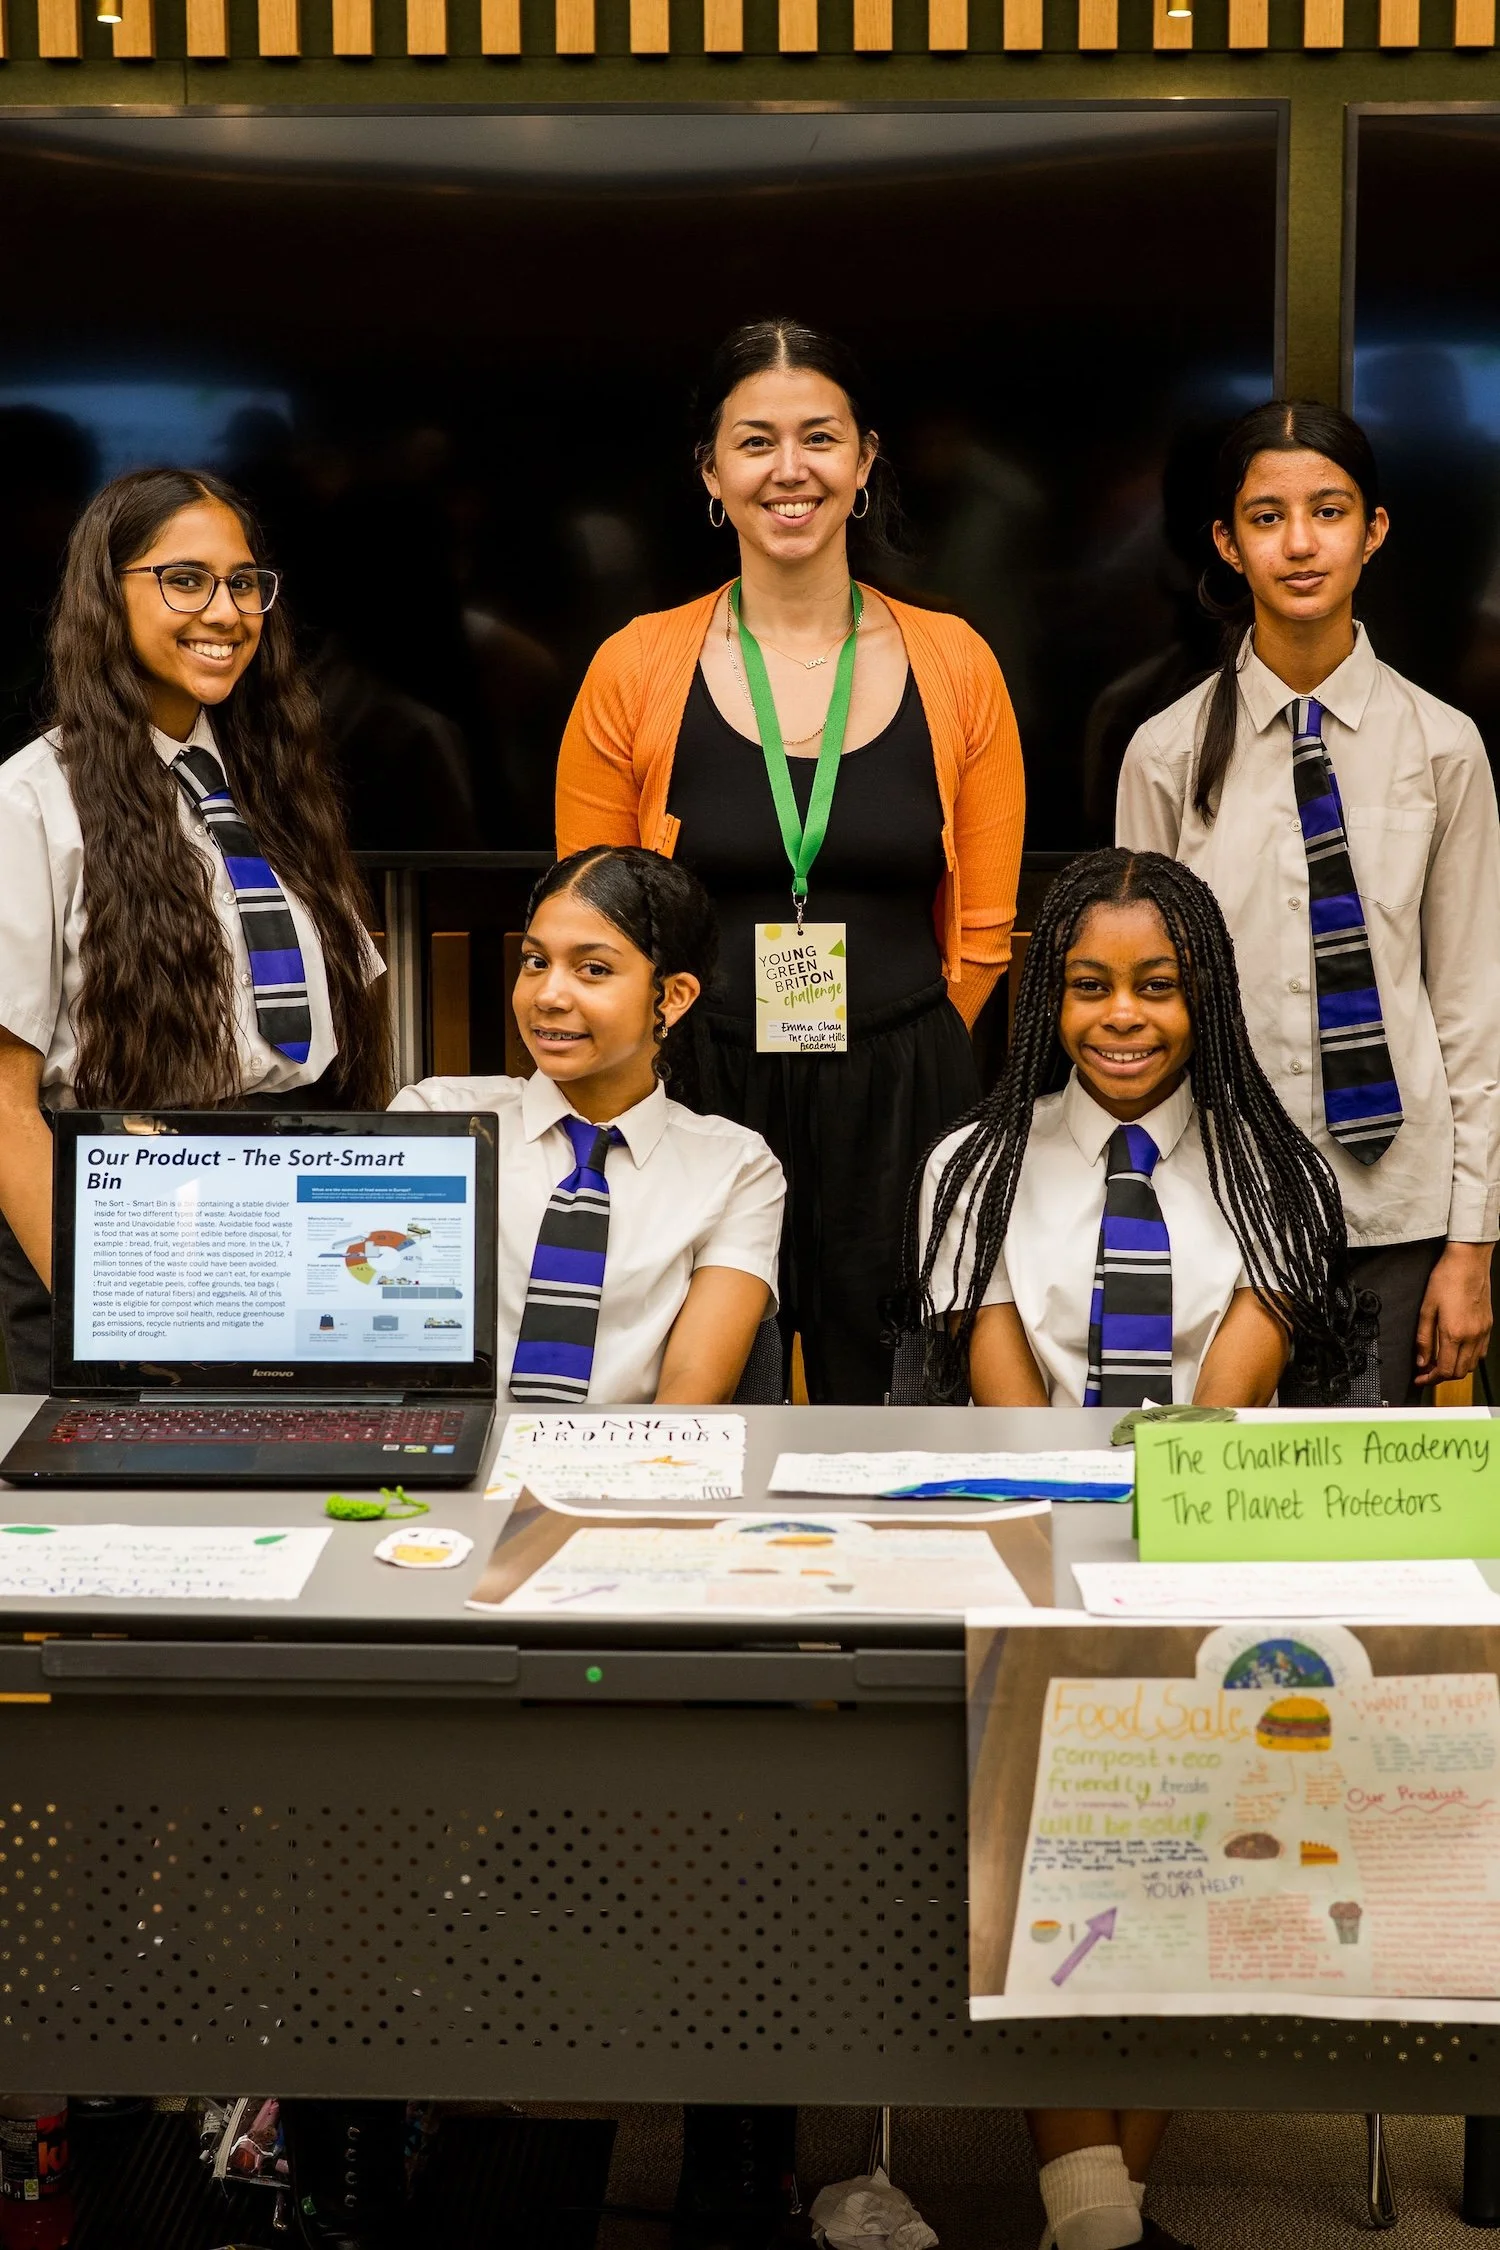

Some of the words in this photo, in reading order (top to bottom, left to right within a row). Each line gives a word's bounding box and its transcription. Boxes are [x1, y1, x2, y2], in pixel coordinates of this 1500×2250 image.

[759, 946, 817, 967] YOUNG
[766, 959, 817, 980] GREEN
[775, 970, 834, 992] BRITON
[784, 982, 842, 1008] challenge
[782, 1022, 814, 1032] Emma
[804, 1033, 825, 1042] Chalk
[829, 1032, 845, 1041] Hills
[800, 1042, 836, 1052] Academy
[87, 1148, 129, 1166] Our
[135, 1148, 220, 1166] Product
[242, 1149, 280, 1166] The
[289, 1150, 405, 1166] Sort-Smart
[87, 1172, 121, 1189] Bin
[174, 1210, 193, 1219] types
[222, 1250, 254, 1259] disposed
[265, 1250, 285, 1259] 2012,
[234, 1270, 248, 1279] eat,
[261, 1270, 291, 1279] example
[165, 1280, 186, 1289] peels,
[212, 1280, 242, 1289] grounds,
[258, 1280, 275, 1289] bags
[172, 1290, 195, 1299] fibers)
[123, 1300, 148, 1309] eligible
[162, 1300, 192, 1309] compost
[255, 1300, 285, 1309] compost
[147, 1310, 174, 1319] improve
[190, 1310, 214, 1319] health,
[147, 1320, 171, 1329] recycle
[222, 1320, 250, 1329] mitigate
[138, 1330, 167, 1339] drought.
[253, 1369, 294, 1377] lenovo
[539, 1419, 708, 1429] PLANET
[1154, 1436, 1206, 1475] The
[1363, 1430, 1490, 1473] Academy
[1162, 1491, 1214, 1526] The
[1226, 1488, 1304, 1522] Planet
[1324, 1484, 1442, 1520] Protectors
[1054, 1682, 1144, 1732] Food
[1155, 1684, 1244, 1734] Sale
[1052, 1746, 1160, 1773] compost
[1182, 1752, 1222, 1769] eco
[1048, 1766, 1151, 1802] friendly
[1160, 1775, 1210, 1794] treats
[1348, 1788, 1385, 1804] Our
[1397, 1785, 1468, 1800] Product
[1039, 1812, 1092, 1836] will
[1104, 1813, 1132, 1836] be
[1142, 1871, 1160, 1880] we
[1167, 1867, 1204, 1879] need
[1143, 1881, 1194, 1899] YOUR
